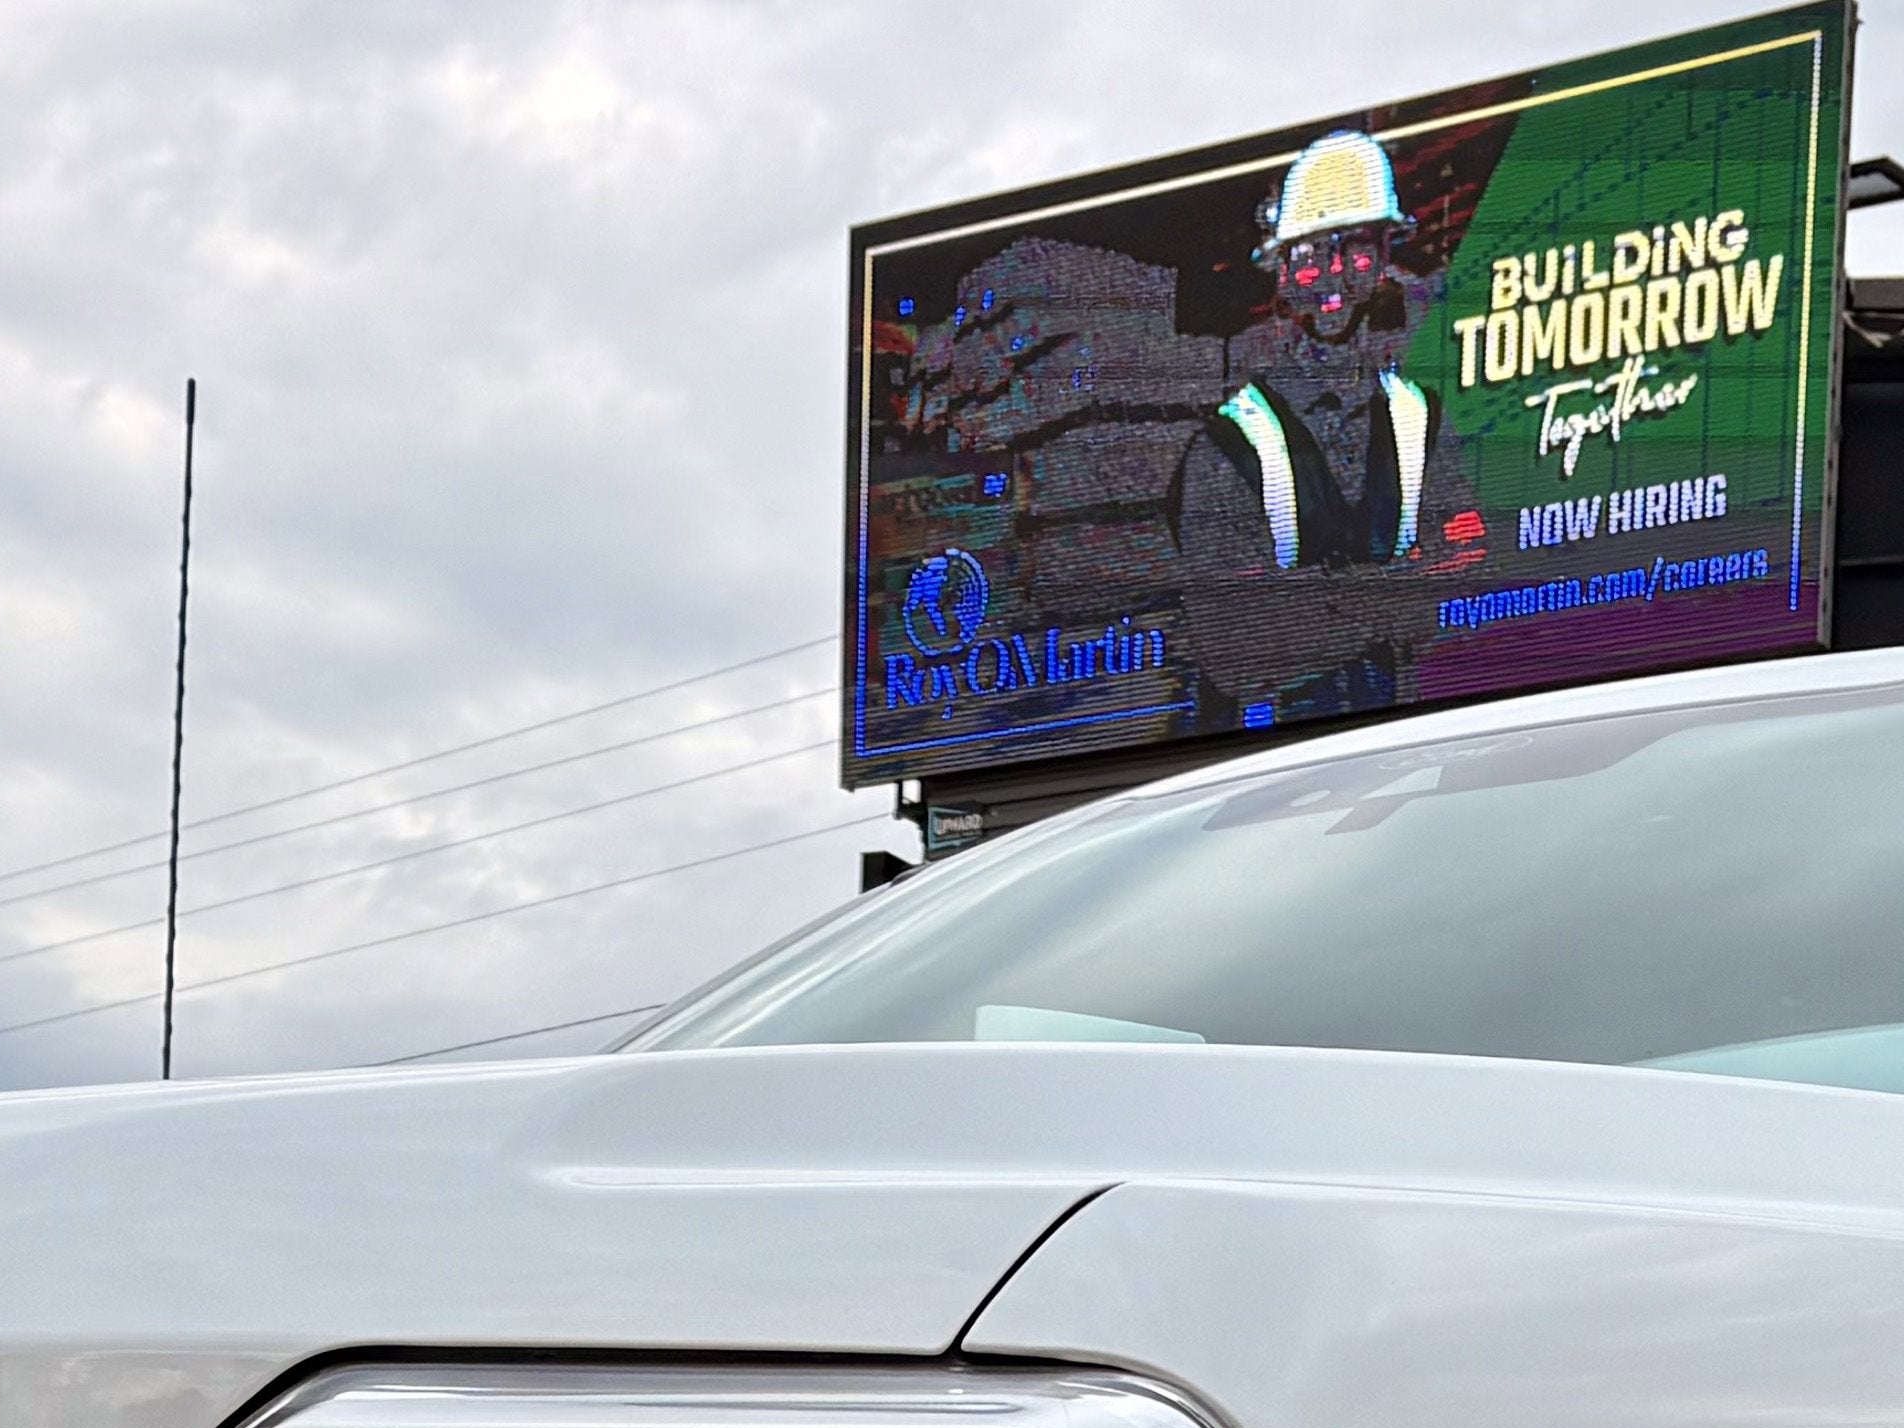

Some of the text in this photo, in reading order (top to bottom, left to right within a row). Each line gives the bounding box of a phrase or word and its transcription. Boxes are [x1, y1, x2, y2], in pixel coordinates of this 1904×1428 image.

[1491, 209, 1749, 310] BUILDING
[1453, 254, 1784, 388] TOMORROW
[1525, 355, 1698, 477] Together
[1518, 474, 1727, 550] NOW HIRING
